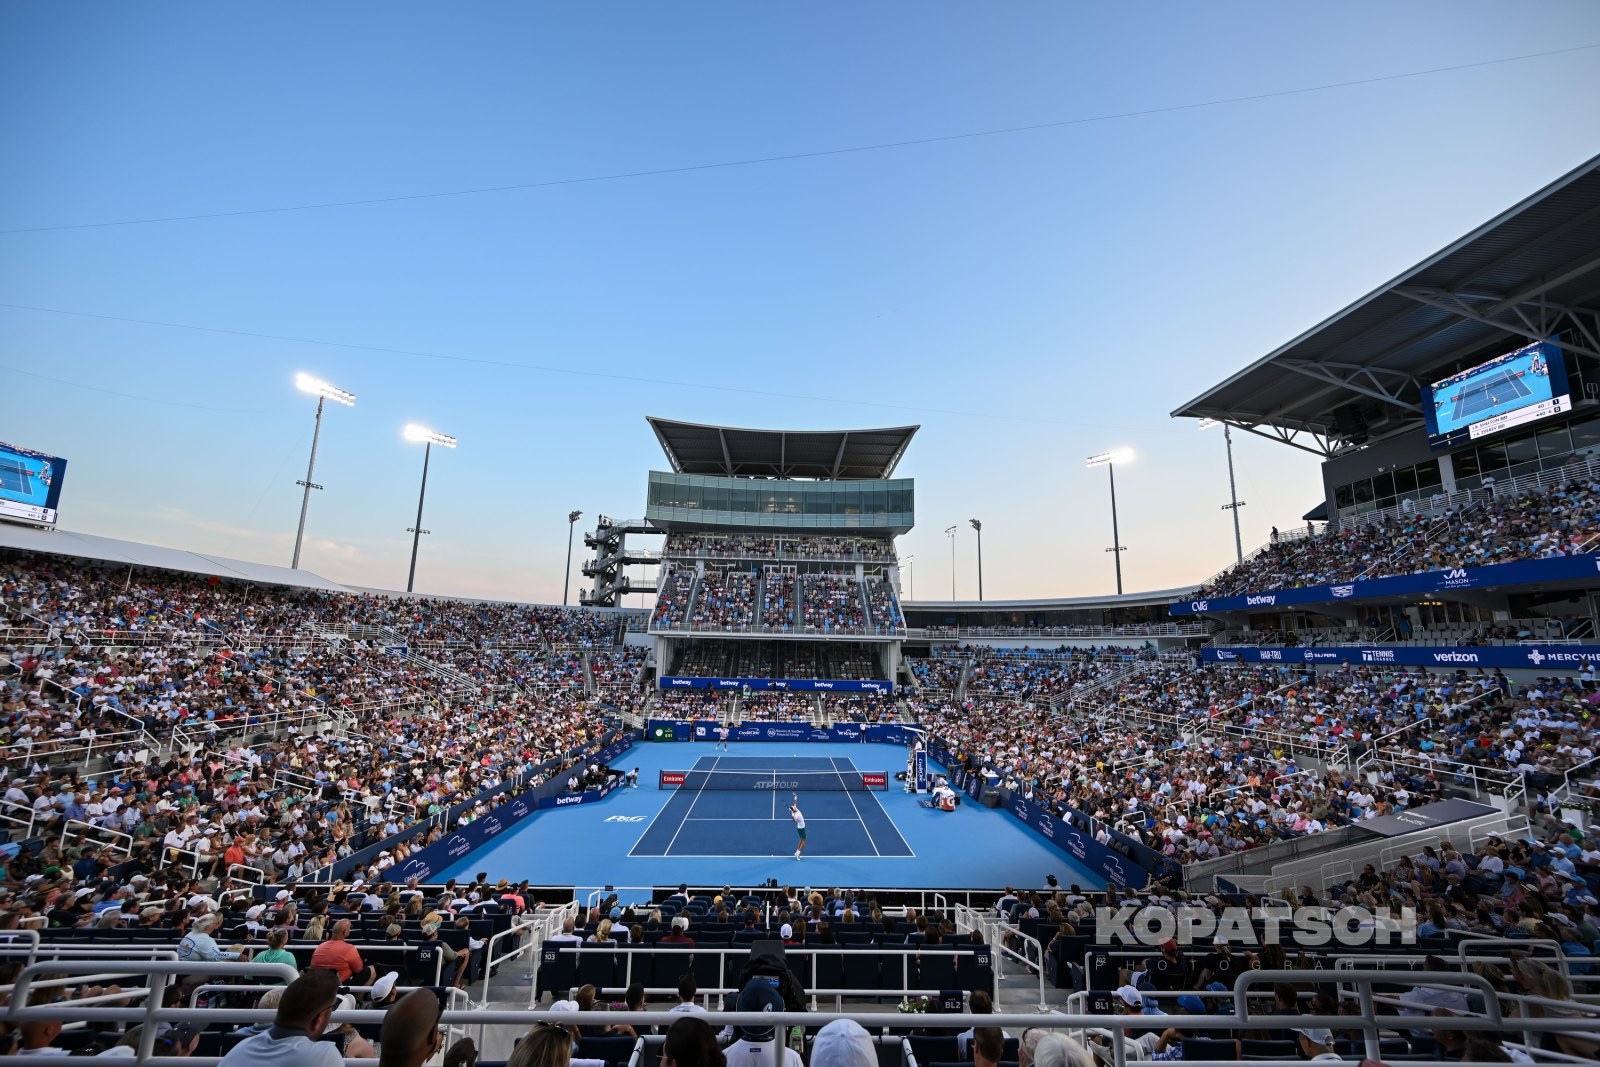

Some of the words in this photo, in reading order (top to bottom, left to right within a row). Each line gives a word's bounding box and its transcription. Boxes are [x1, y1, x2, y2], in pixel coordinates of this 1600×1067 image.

[1247, 595, 1276, 605] betway
[1372, 650, 1394, 658] TENNIS
[1434, 651, 1478, 662] verizon
[815, 681, 834, 689] betway
[862, 682, 880, 690] betway
[774, 781, 799, 789] TOUR
[557, 796, 582, 804] betway
[945, 1001, 961, 1009] BL2
[1095, 1001, 1109, 1009] BL1
